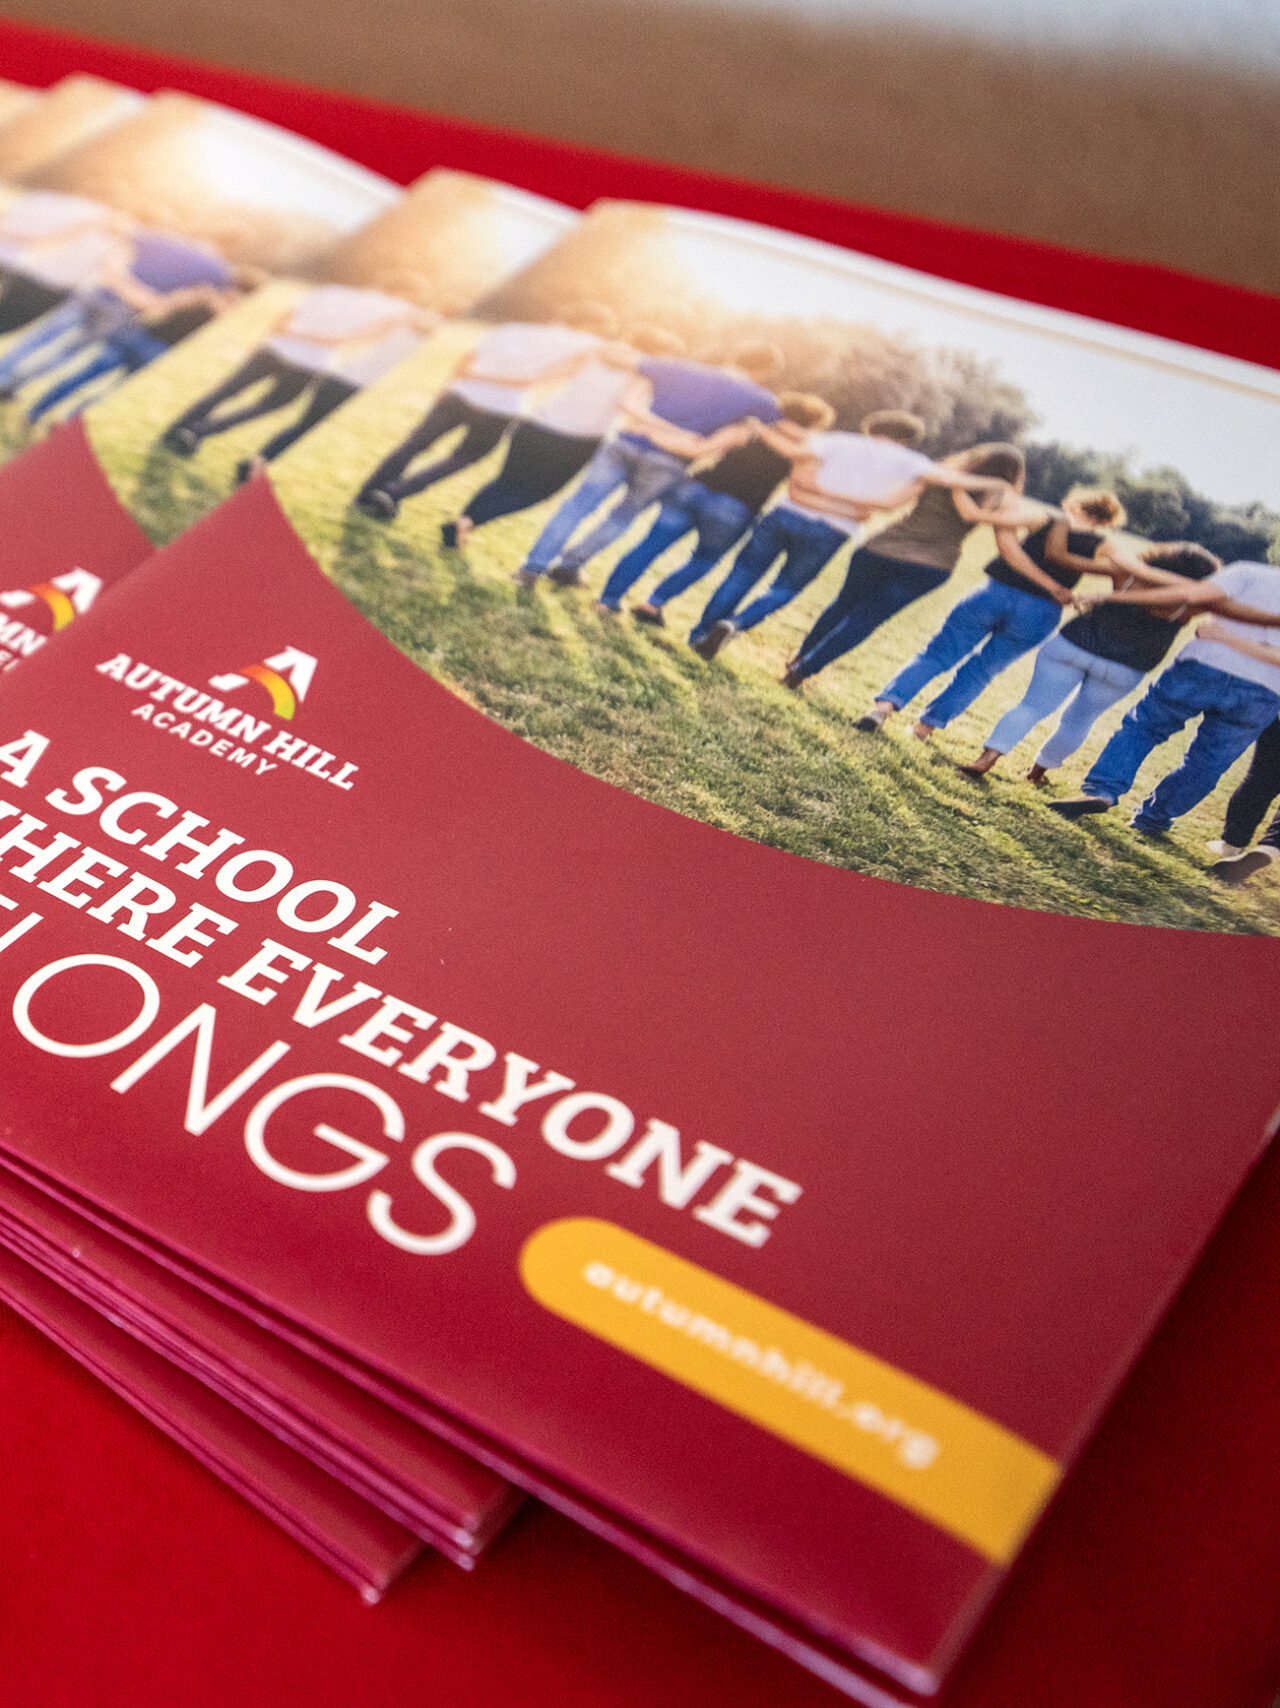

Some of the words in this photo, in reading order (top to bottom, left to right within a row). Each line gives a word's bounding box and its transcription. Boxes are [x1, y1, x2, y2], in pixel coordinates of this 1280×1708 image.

[94, 653, 272, 744] AUTUMN
[261, 730, 360, 791] HILL
[130, 702, 279, 776] ACADEMY
[43, 766, 401, 965] SCHOOL
[216, 938, 803, 1247] EVERYONE
[582, 1261, 941, 1471] autumnhill.org
